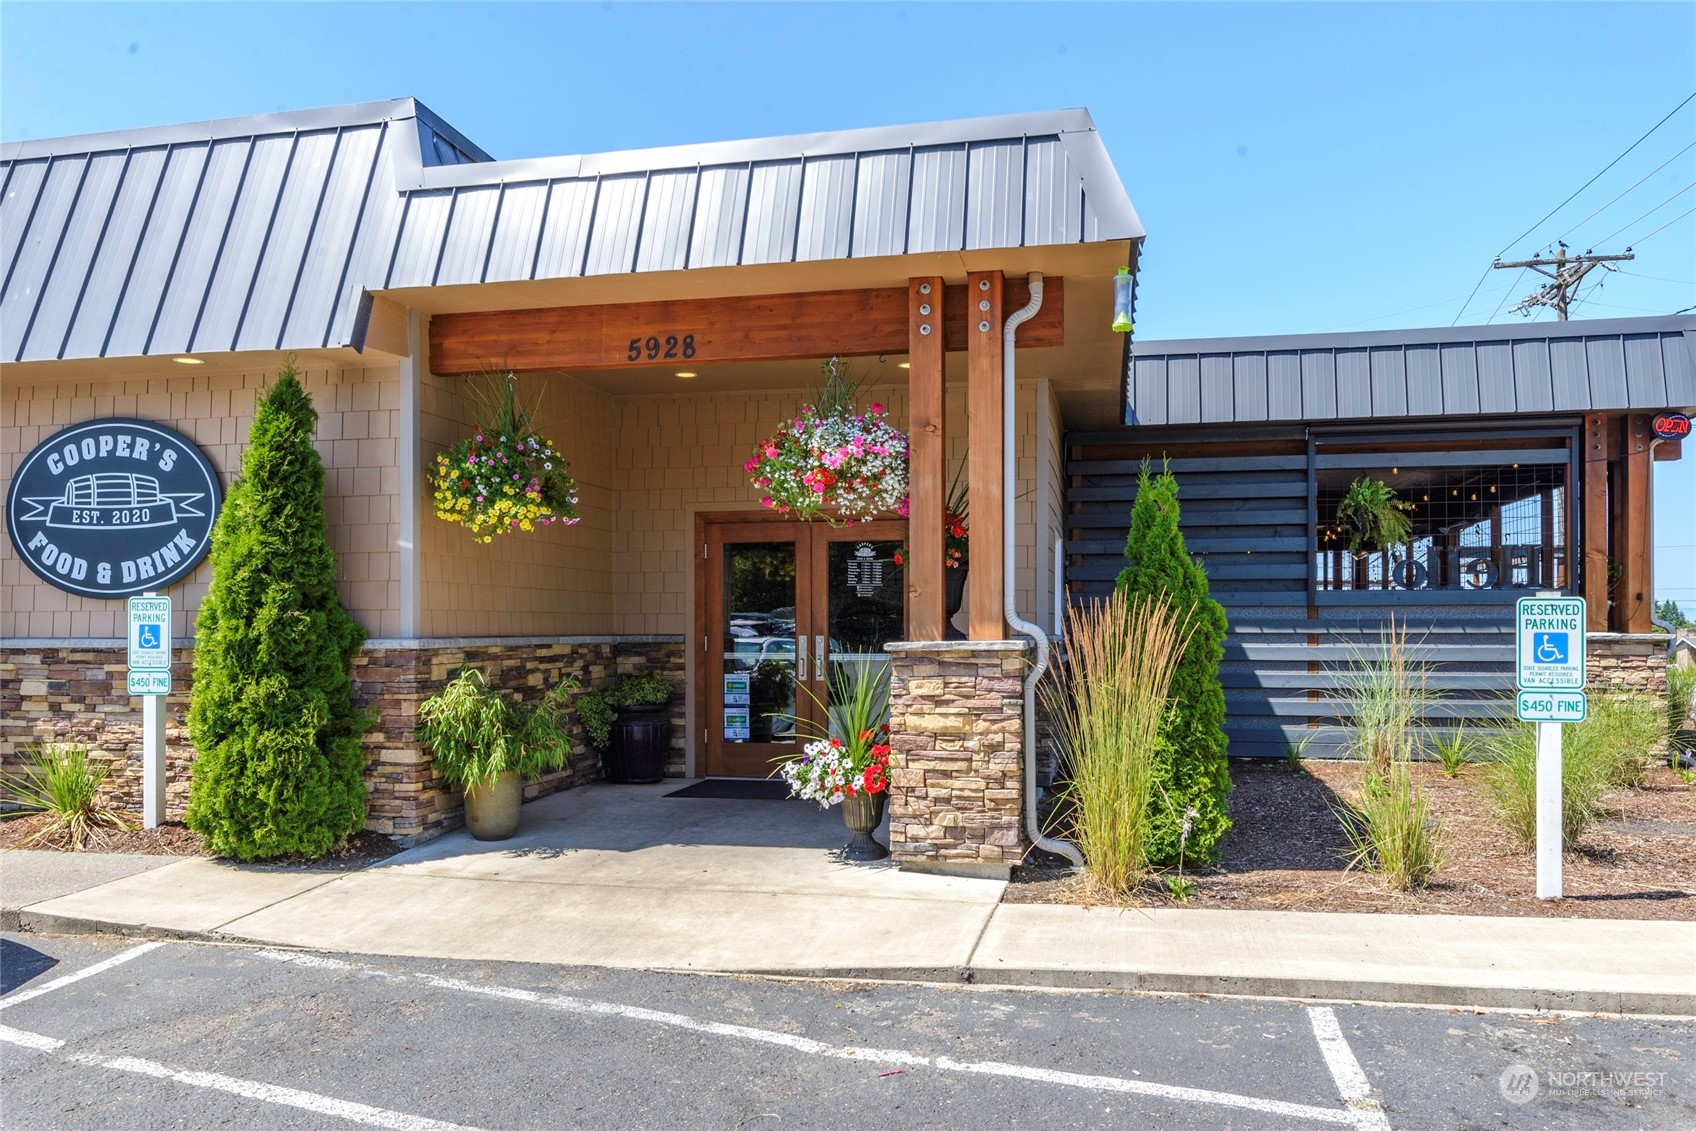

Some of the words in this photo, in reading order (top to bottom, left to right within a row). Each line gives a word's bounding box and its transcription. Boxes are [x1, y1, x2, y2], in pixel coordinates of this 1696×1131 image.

[628, 334, 696, 361] 5928
[47, 435, 178, 475] COOPER'S
[72, 510, 104, 524] EST.
[112, 508, 150, 524] 2020
[28, 531, 88, 580] FOOD
[96, 562, 112, 584] &
[121, 528, 197, 583] DRINK
[131, 602, 168, 611] RESERVED
[1522, 604, 1580, 616] RESERVED
[133, 613, 166, 622] PARKING
[1525, 618, 1577, 630] PARKING
[130, 677, 150, 687] $450
[152, 677, 168, 687] FINE
[1521, 699, 1553, 712] $450
[1557, 700, 1582, 712] FINE
